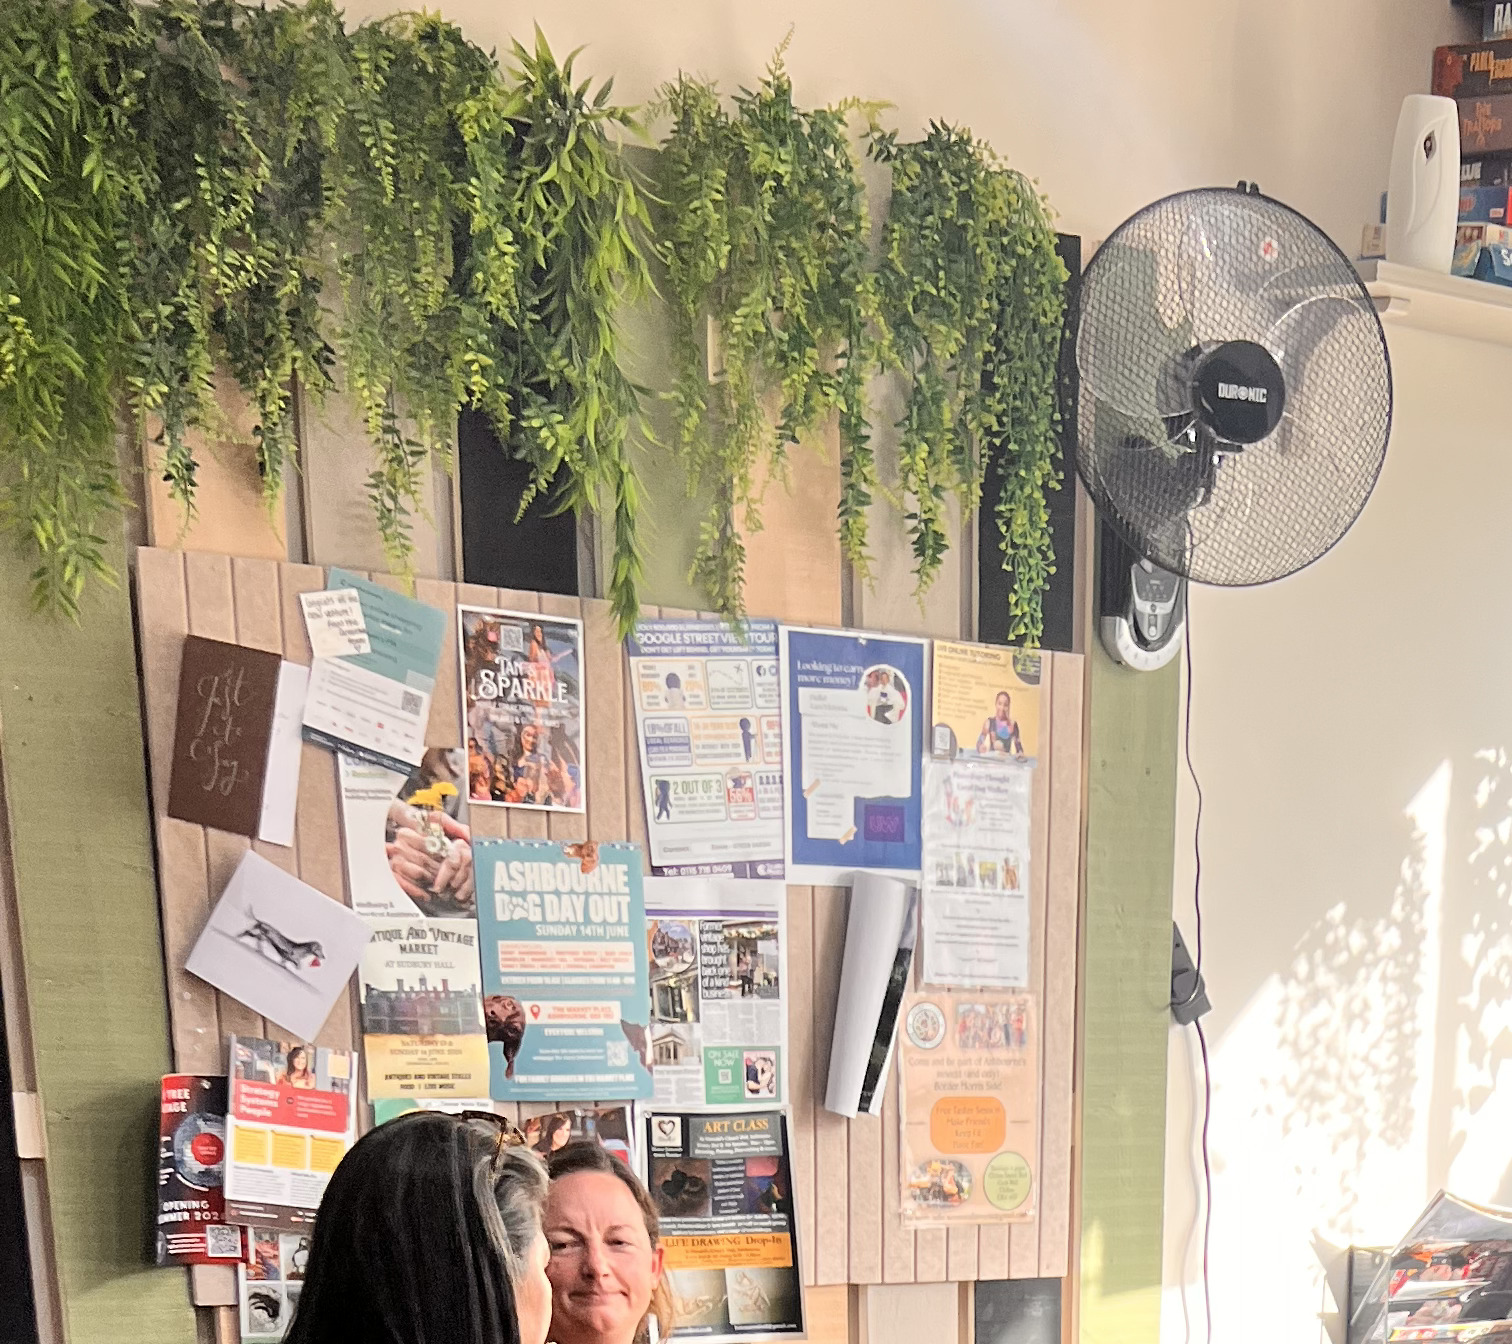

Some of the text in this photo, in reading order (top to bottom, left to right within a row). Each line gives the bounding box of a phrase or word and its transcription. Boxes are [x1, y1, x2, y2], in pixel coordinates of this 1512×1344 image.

[637, 631, 682, 645] GOOGLE
[683, 632, 718, 646] STREET
[494, 656, 524, 676] TAN
[797, 660, 832, 675] Looking
[475, 669, 569, 704] SPARKLE
[797, 674, 822, 684] more
[673, 782, 681, 795] 2
[682, 781, 700, 795] OUT
[702, 780, 714, 794] OF
[494, 861, 630, 894] ASHBOURNE
[543, 894, 586, 923] DAY
[588, 895, 631, 923] OUT
[536, 924, 630, 940] SUNDAY 14TH JUNE
[399, 943, 440, 956] MARKET
[434, 960, 455, 970] HALL
[707, 1050, 740, 1060] ON SALE
[714, 1058, 736, 1068] NOW
[240, 1083, 280, 1100] Strategy
[240, 1094, 279, 1109] Systems
[240, 1105, 272, 1118] People
[704, 1118, 769, 1133] ART CLASS
[162, 1200, 210, 1213] OPENING
[665, 1238, 690, 1249] LIFE
[691, 1237, 741, 1248] DRAWING
